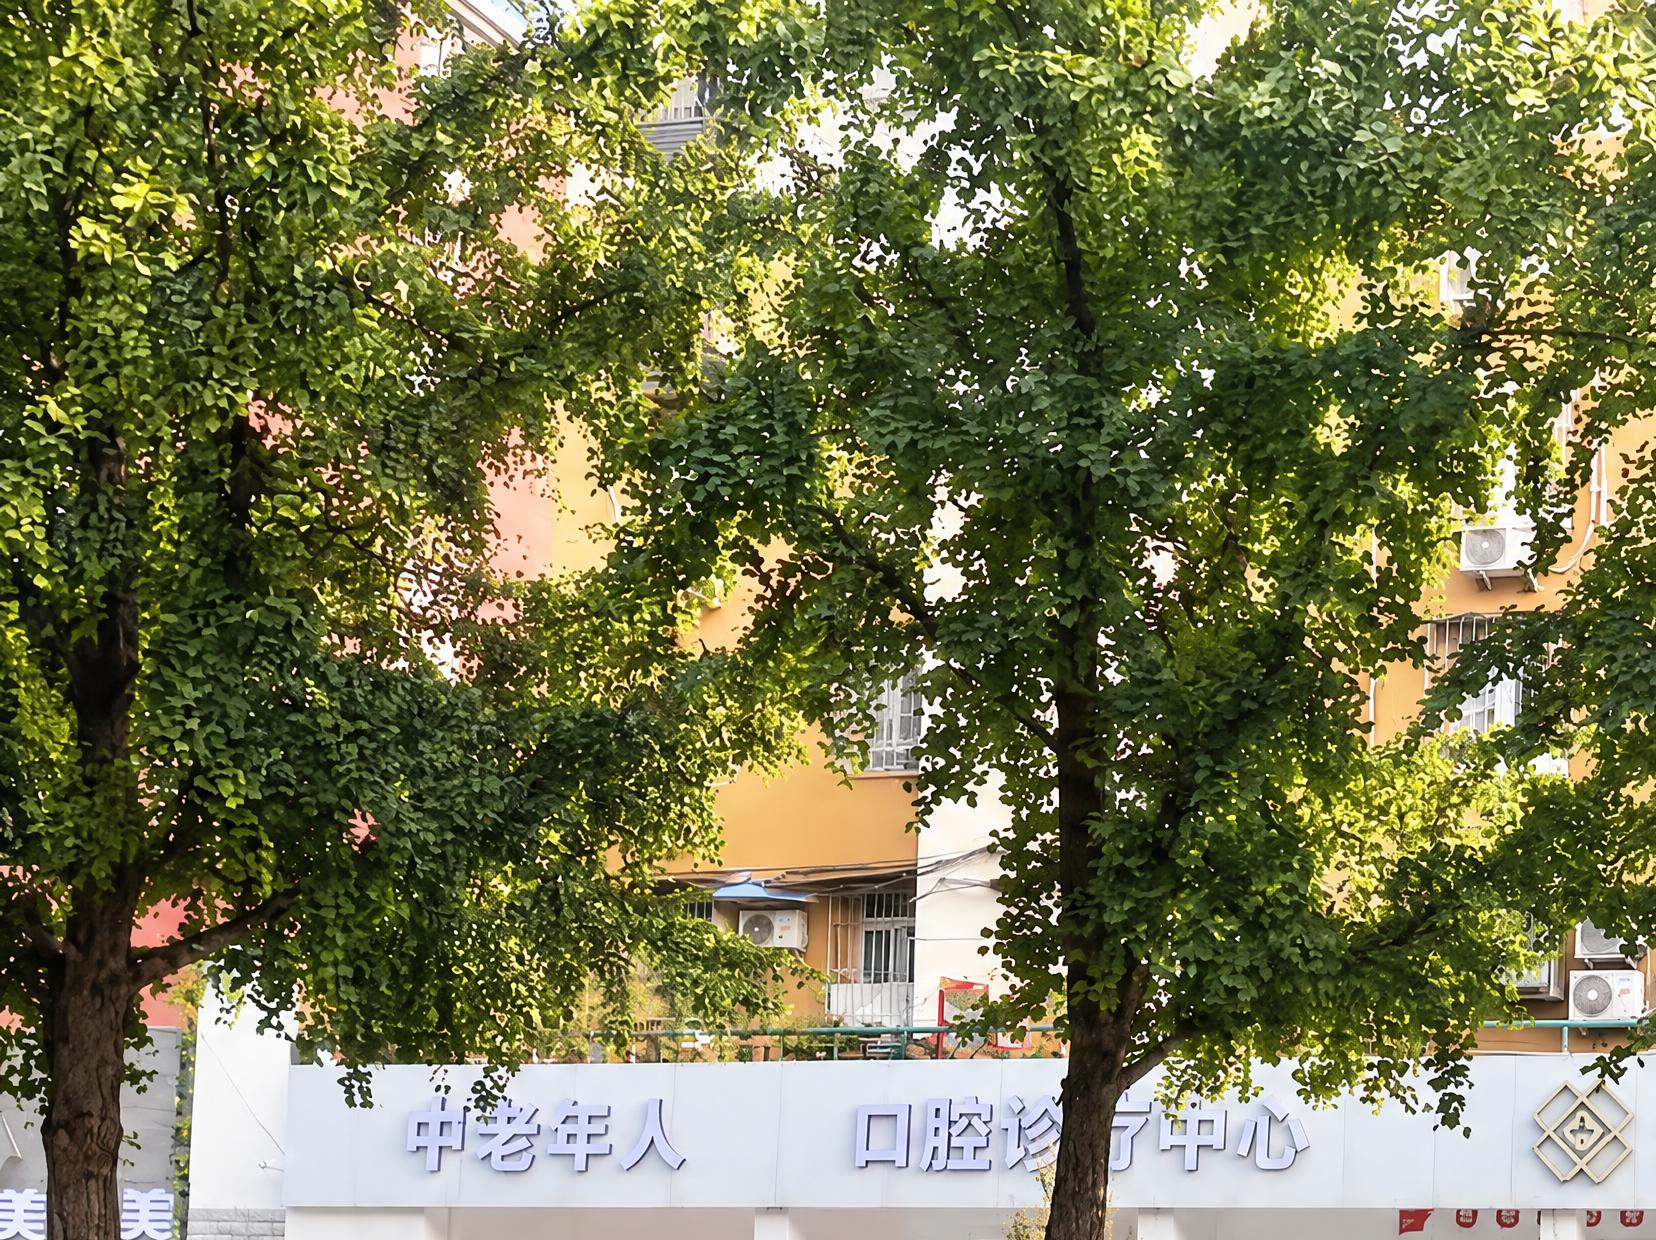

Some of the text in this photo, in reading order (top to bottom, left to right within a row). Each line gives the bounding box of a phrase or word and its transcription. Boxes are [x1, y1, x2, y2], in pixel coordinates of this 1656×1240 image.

[406, 1095, 687, 1173] 中老年人
[854, 1095, 1311, 1173] 口腔诊疗中心
